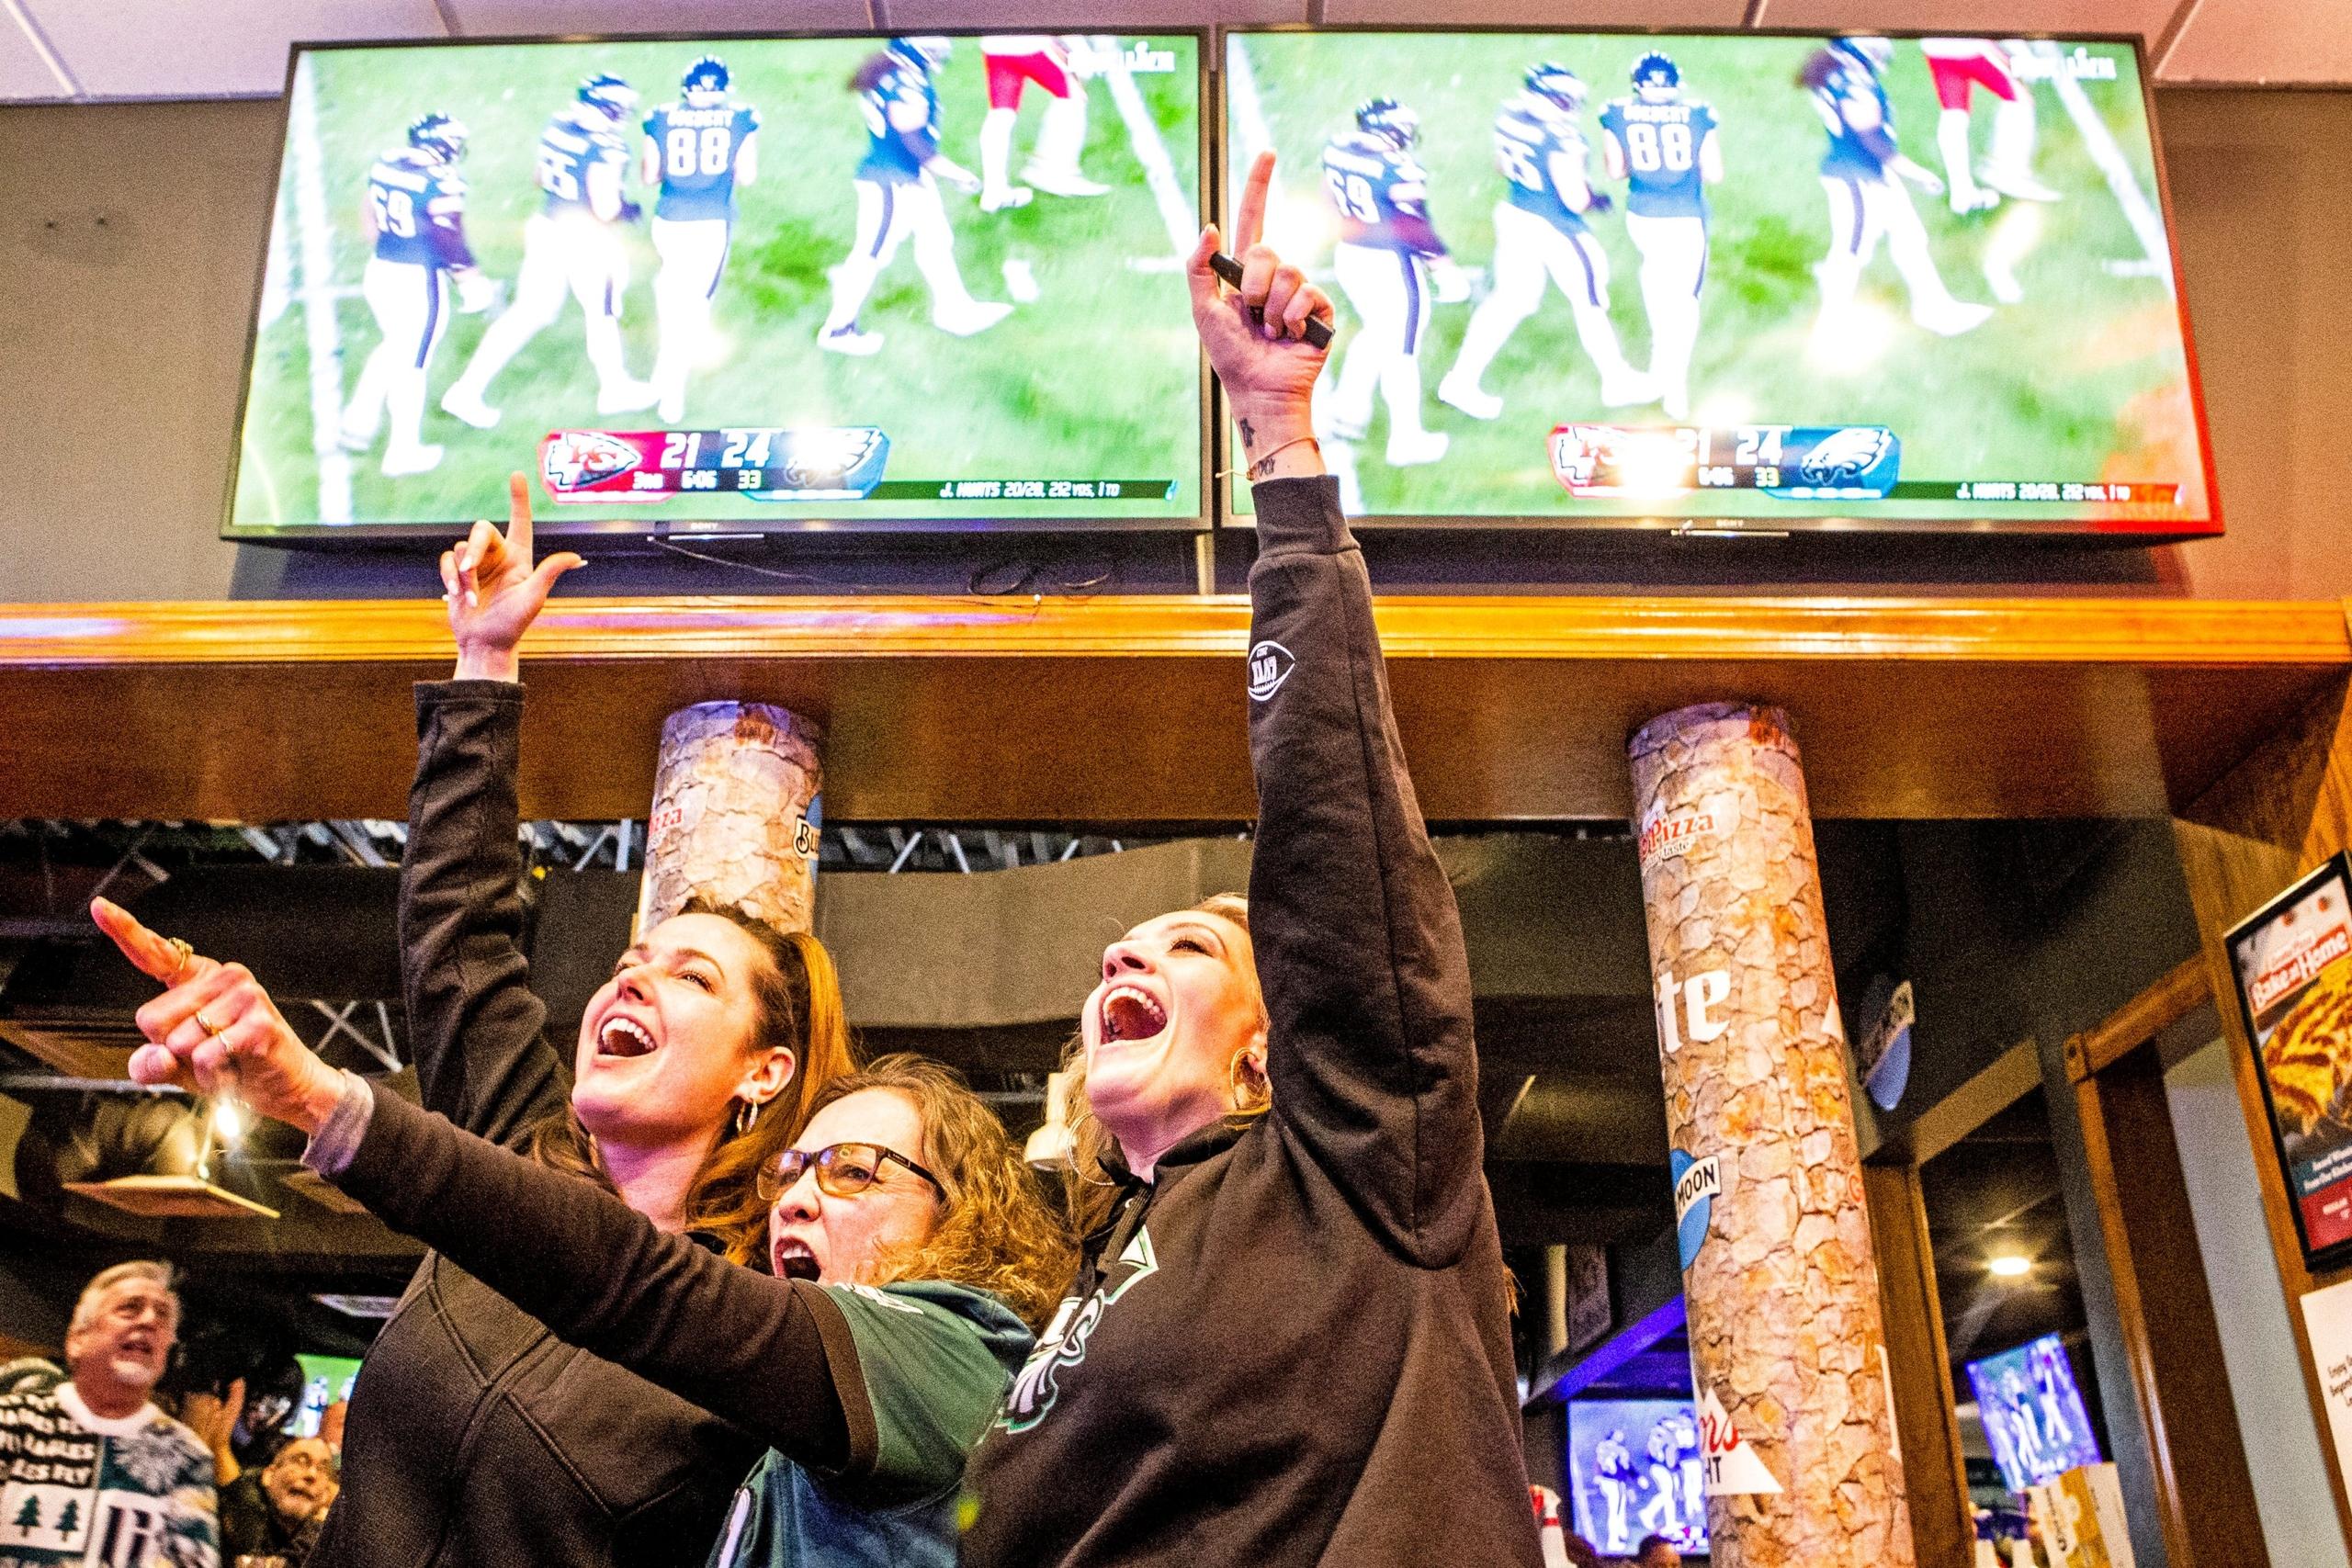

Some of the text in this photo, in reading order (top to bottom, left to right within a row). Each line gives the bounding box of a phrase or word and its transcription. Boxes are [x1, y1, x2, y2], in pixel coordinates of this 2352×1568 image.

[667, 127, 731, 177] 88
[1626, 122, 1692, 172] 88
[660, 433, 771, 468] 21 24
[1736, 428, 1782, 466] 24
[738, 469, 761, 489] 33
[1755, 468, 1779, 487] 33
[1649, 814, 1714, 849] Pizza
[2297, 931, 2349, 980] Home
[1657, 970, 1730, 1054] te
[1677, 1163, 1715, 1215] MOON
